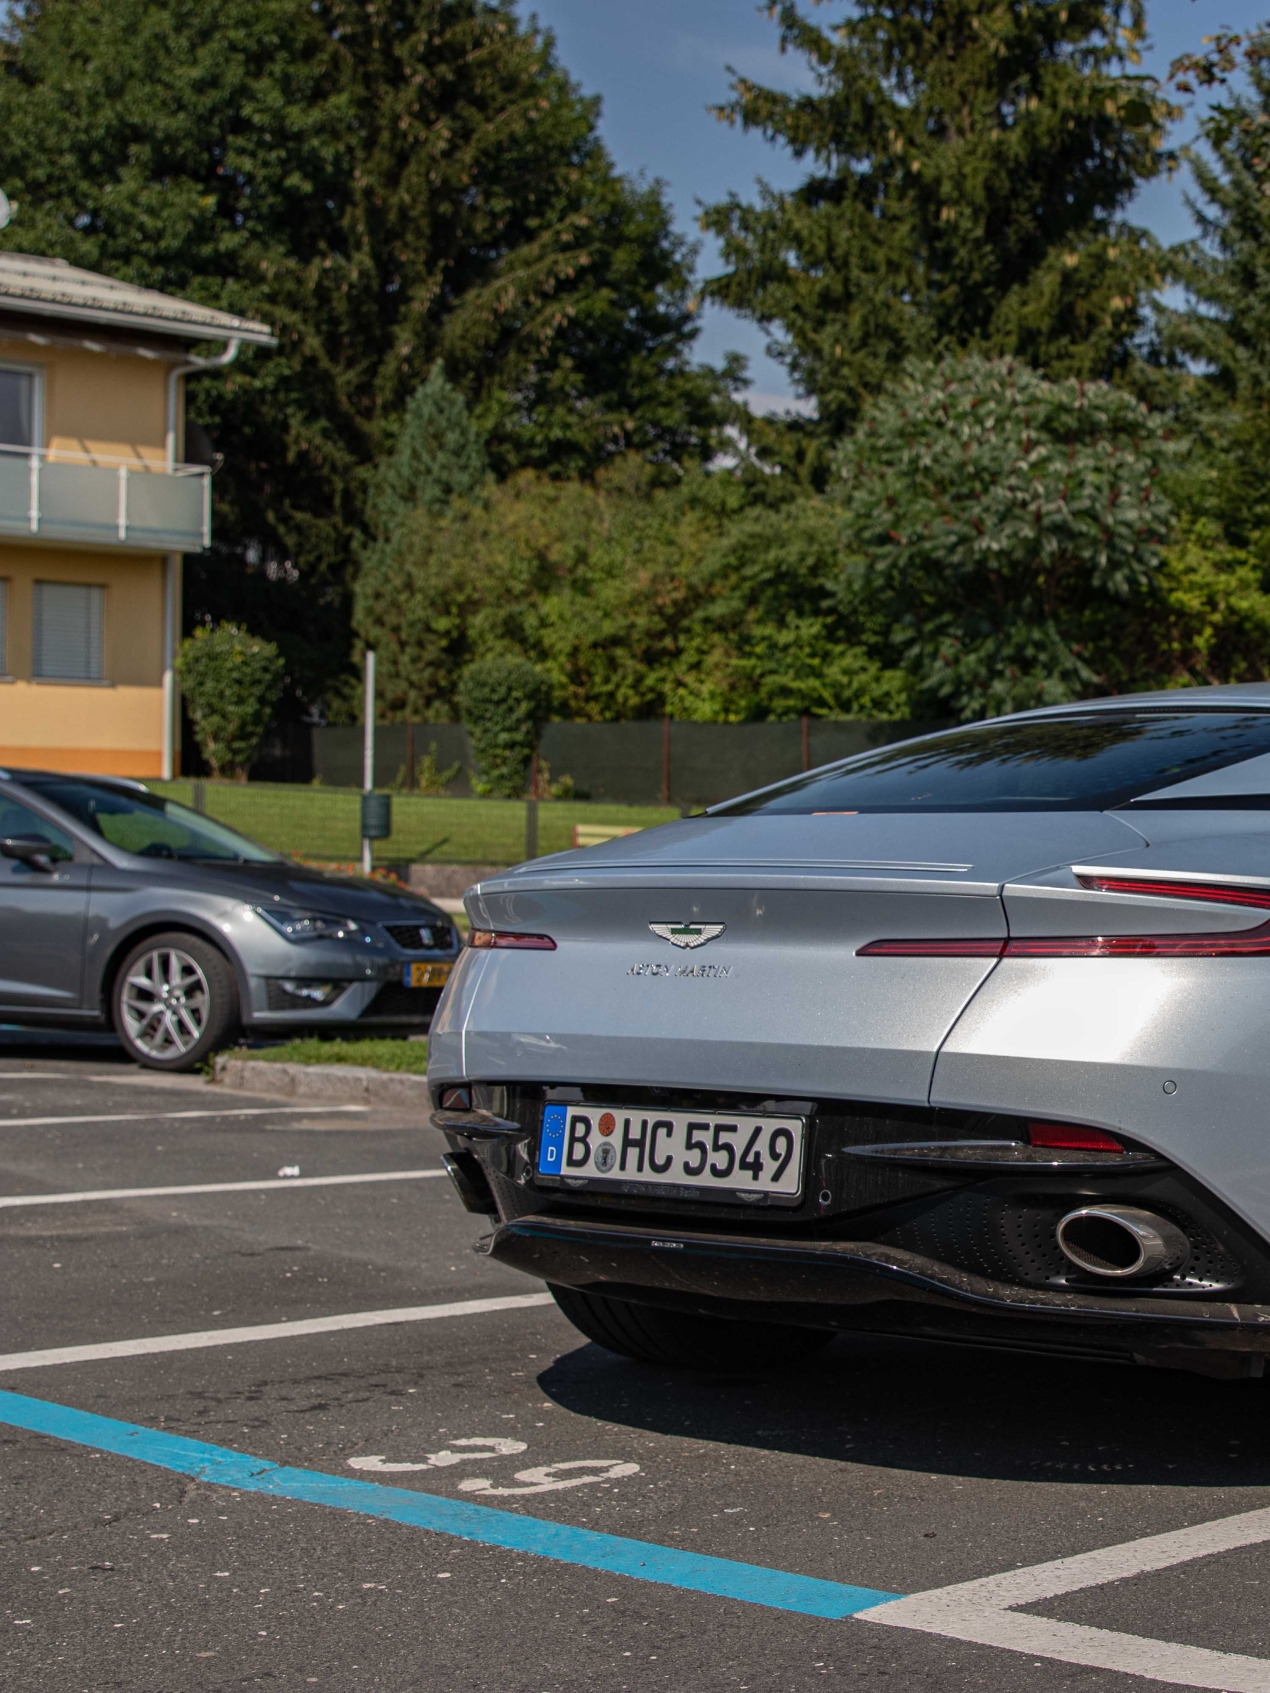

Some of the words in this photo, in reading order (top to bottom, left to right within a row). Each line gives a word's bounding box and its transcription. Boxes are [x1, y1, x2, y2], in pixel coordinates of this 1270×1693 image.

[626, 963, 674, 977] ASTON
[675, 964, 733, 978] MARTIN
[547, 1146, 556, 1162] D
[566, 1113, 593, 1168] B
[619, 1117, 675, 1174] HC
[683, 1121, 795, 1183] 5549
